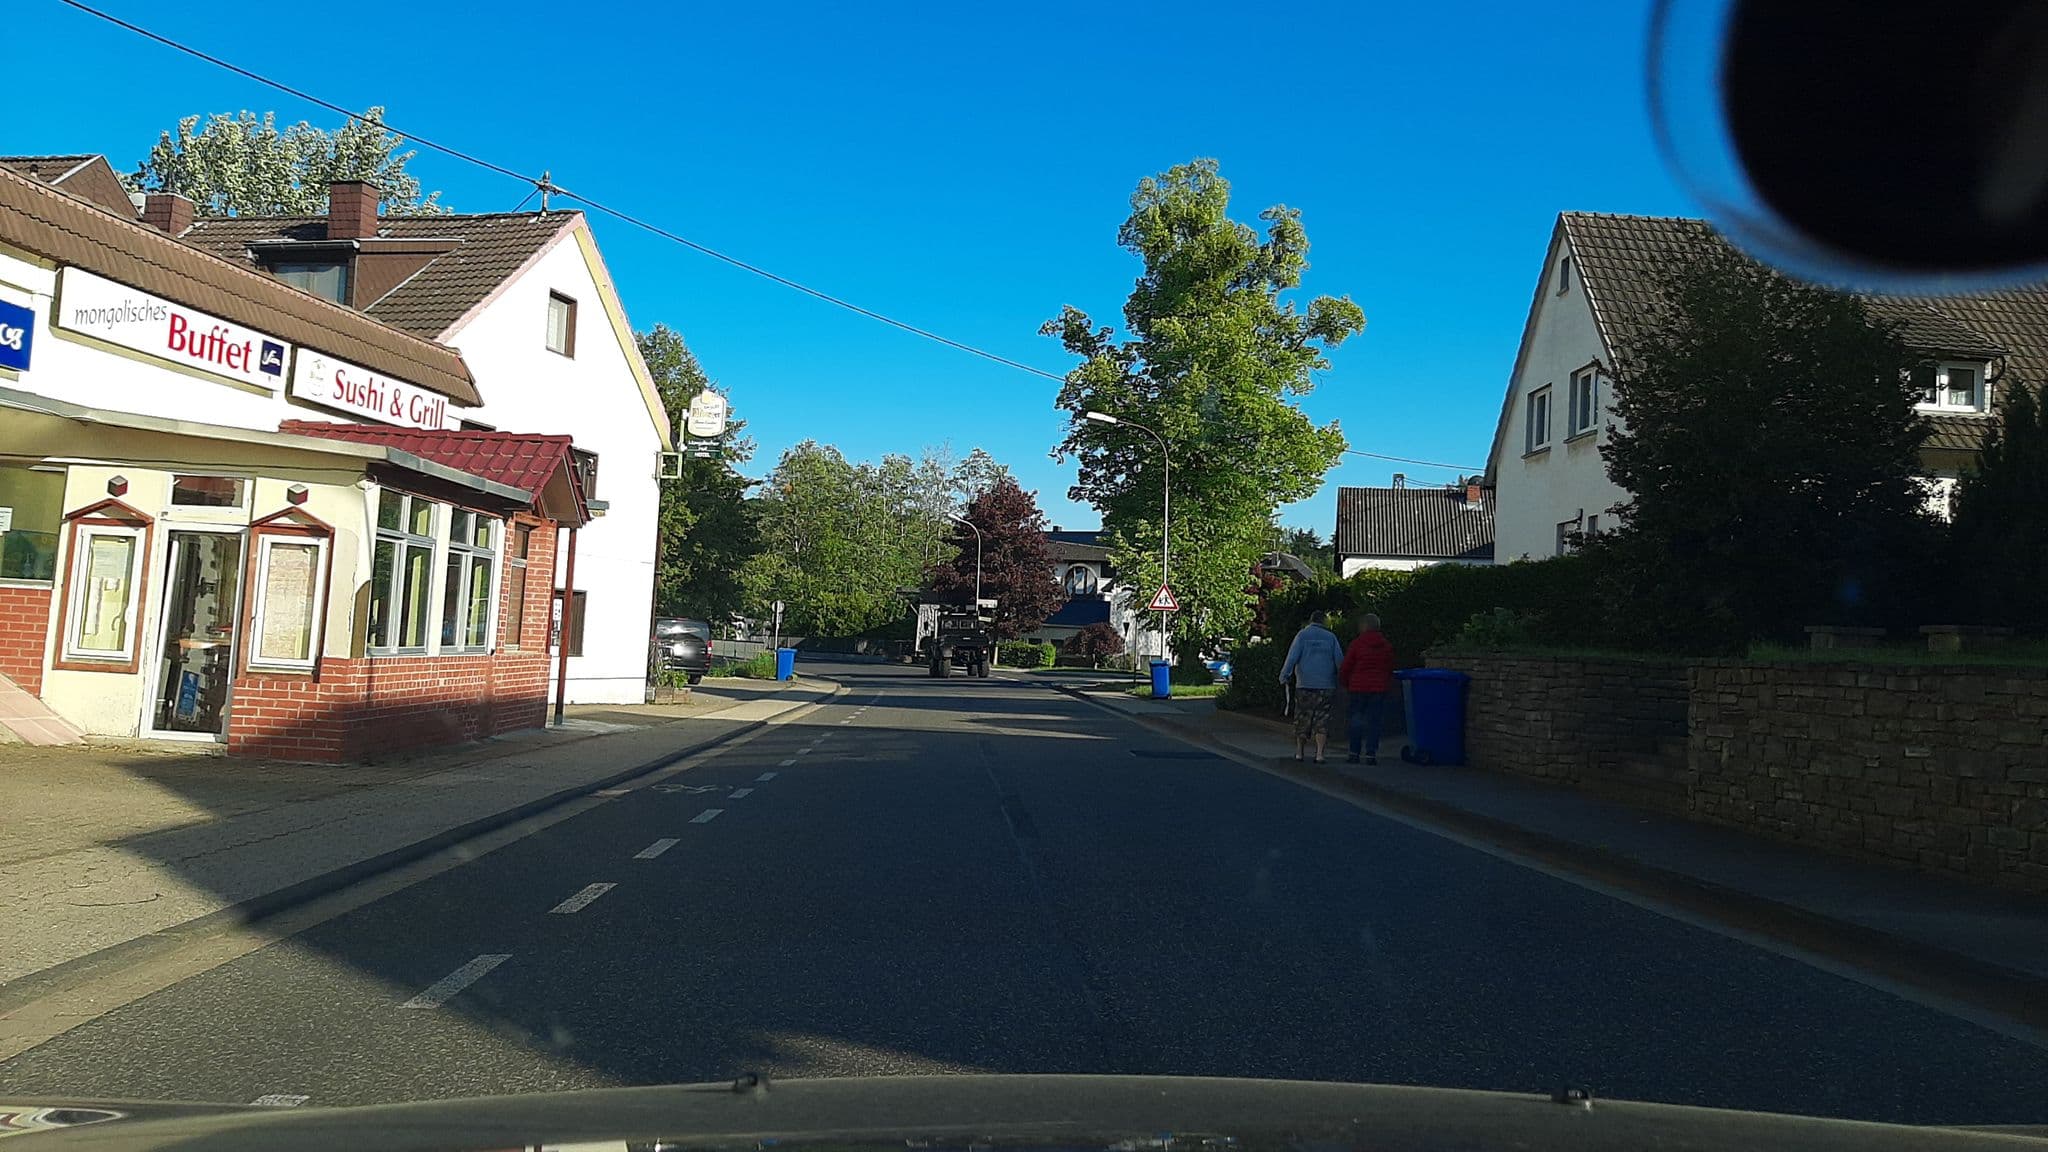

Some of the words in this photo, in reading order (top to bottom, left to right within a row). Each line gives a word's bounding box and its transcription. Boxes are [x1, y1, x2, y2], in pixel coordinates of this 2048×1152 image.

[74, 299, 168, 330] mongolisches
[168, 312, 253, 374] Buffet
[332, 369, 385, 413] Sushi
[389, 388, 404, 418] &
[409, 394, 445, 430] Grill
